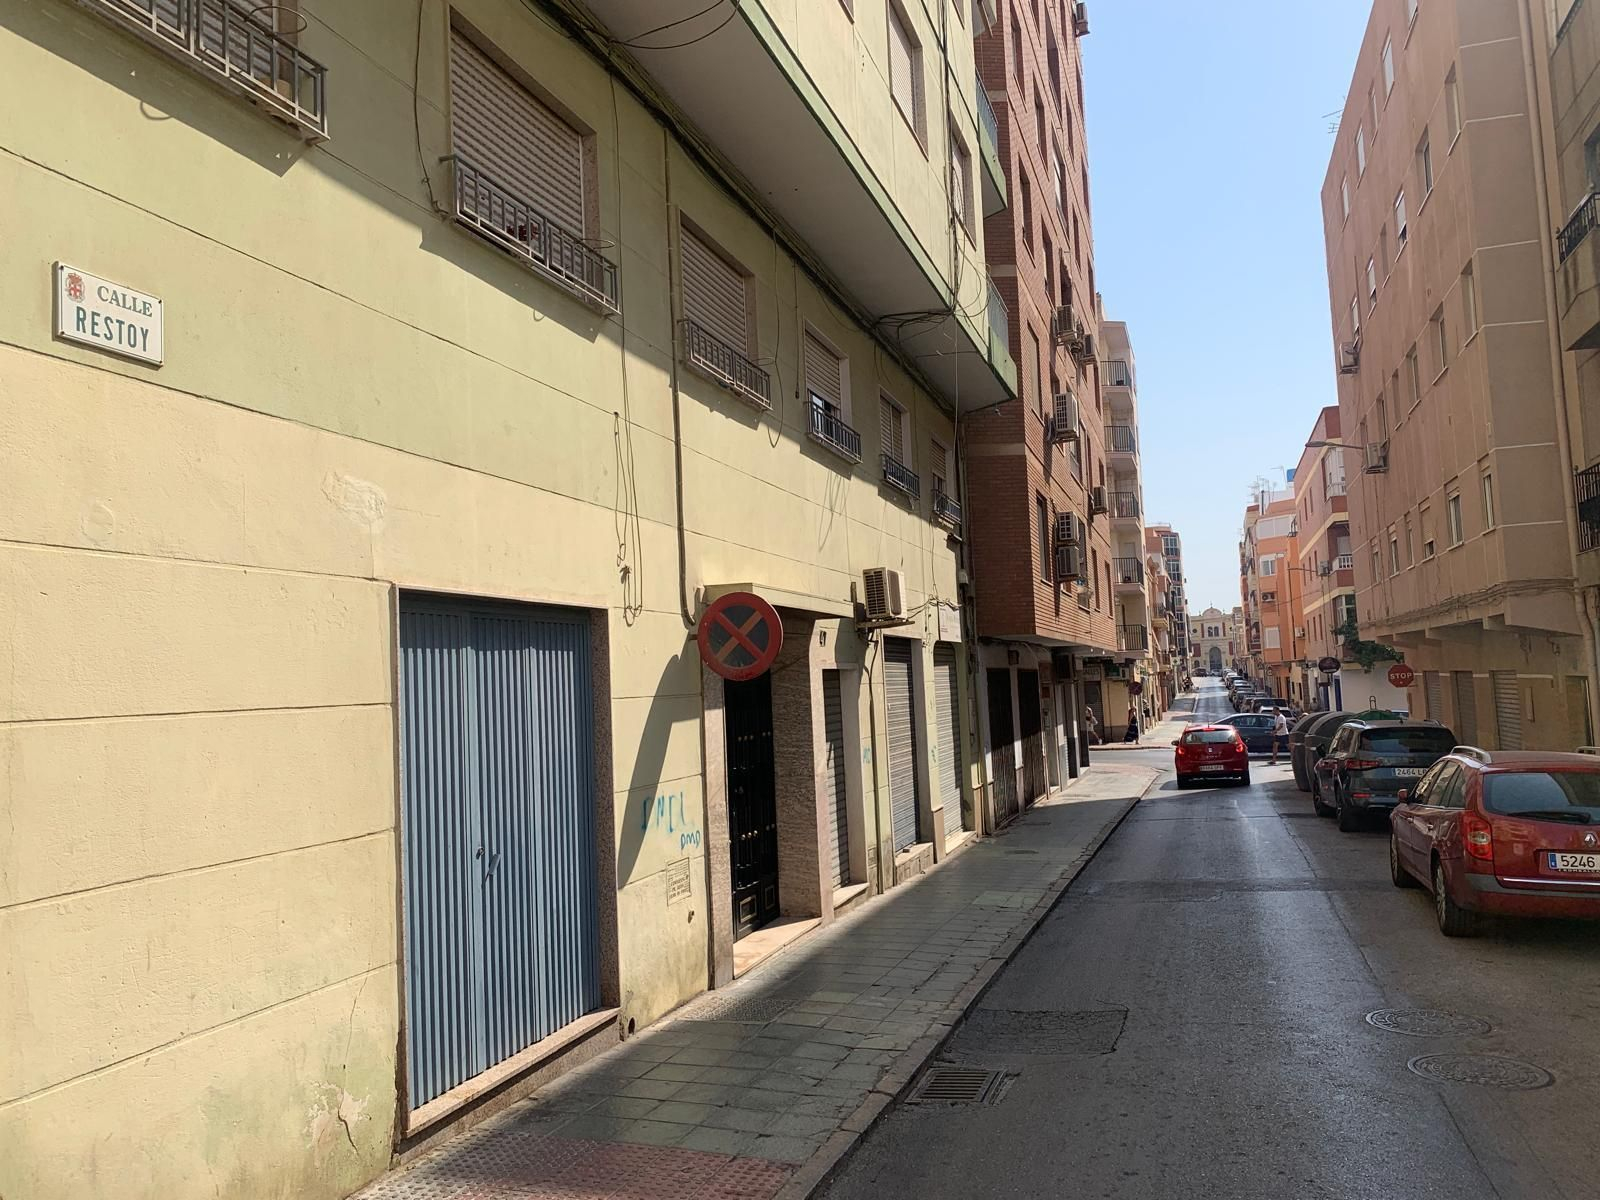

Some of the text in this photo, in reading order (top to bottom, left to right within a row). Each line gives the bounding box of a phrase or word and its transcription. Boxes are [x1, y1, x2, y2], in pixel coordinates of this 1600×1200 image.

[97, 285, 153, 317] CALLE
[76, 306, 149, 352] RESTOY
[1390, 672, 1412, 680] STOP
[1560, 855, 1596, 868] 5246
